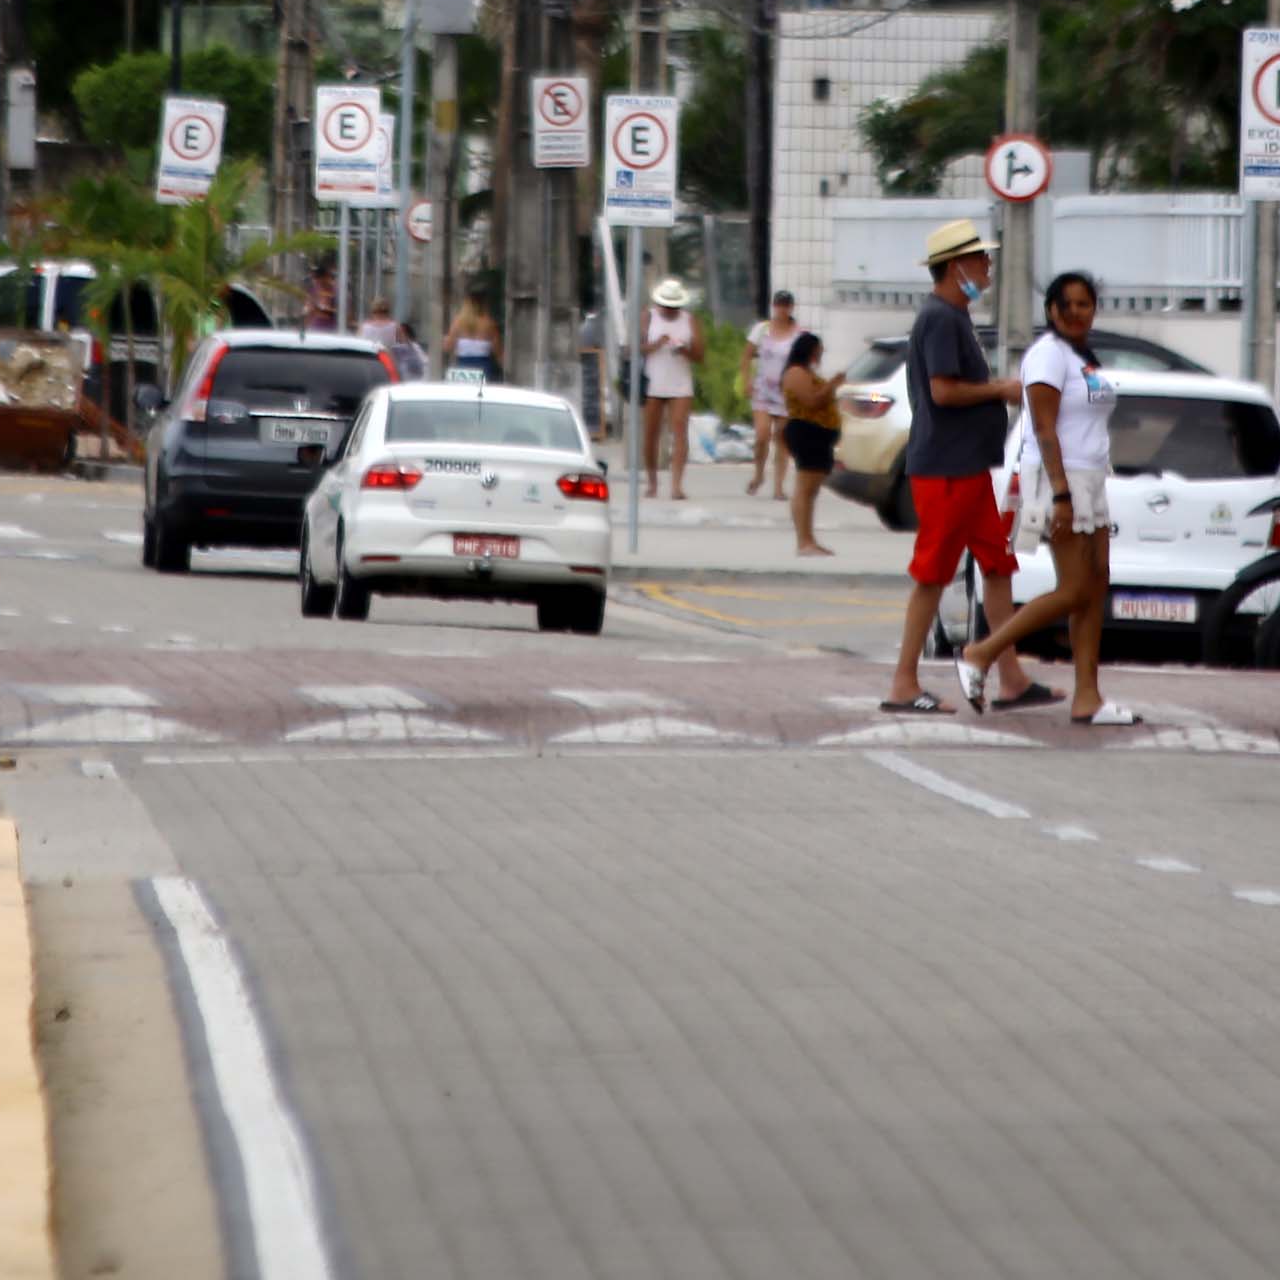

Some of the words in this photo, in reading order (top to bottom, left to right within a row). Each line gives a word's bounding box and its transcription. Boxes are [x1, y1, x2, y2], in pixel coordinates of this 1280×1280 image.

[183, 124, 200, 150] E
[339, 113, 356, 140] E
[631, 126, 650, 156] E
